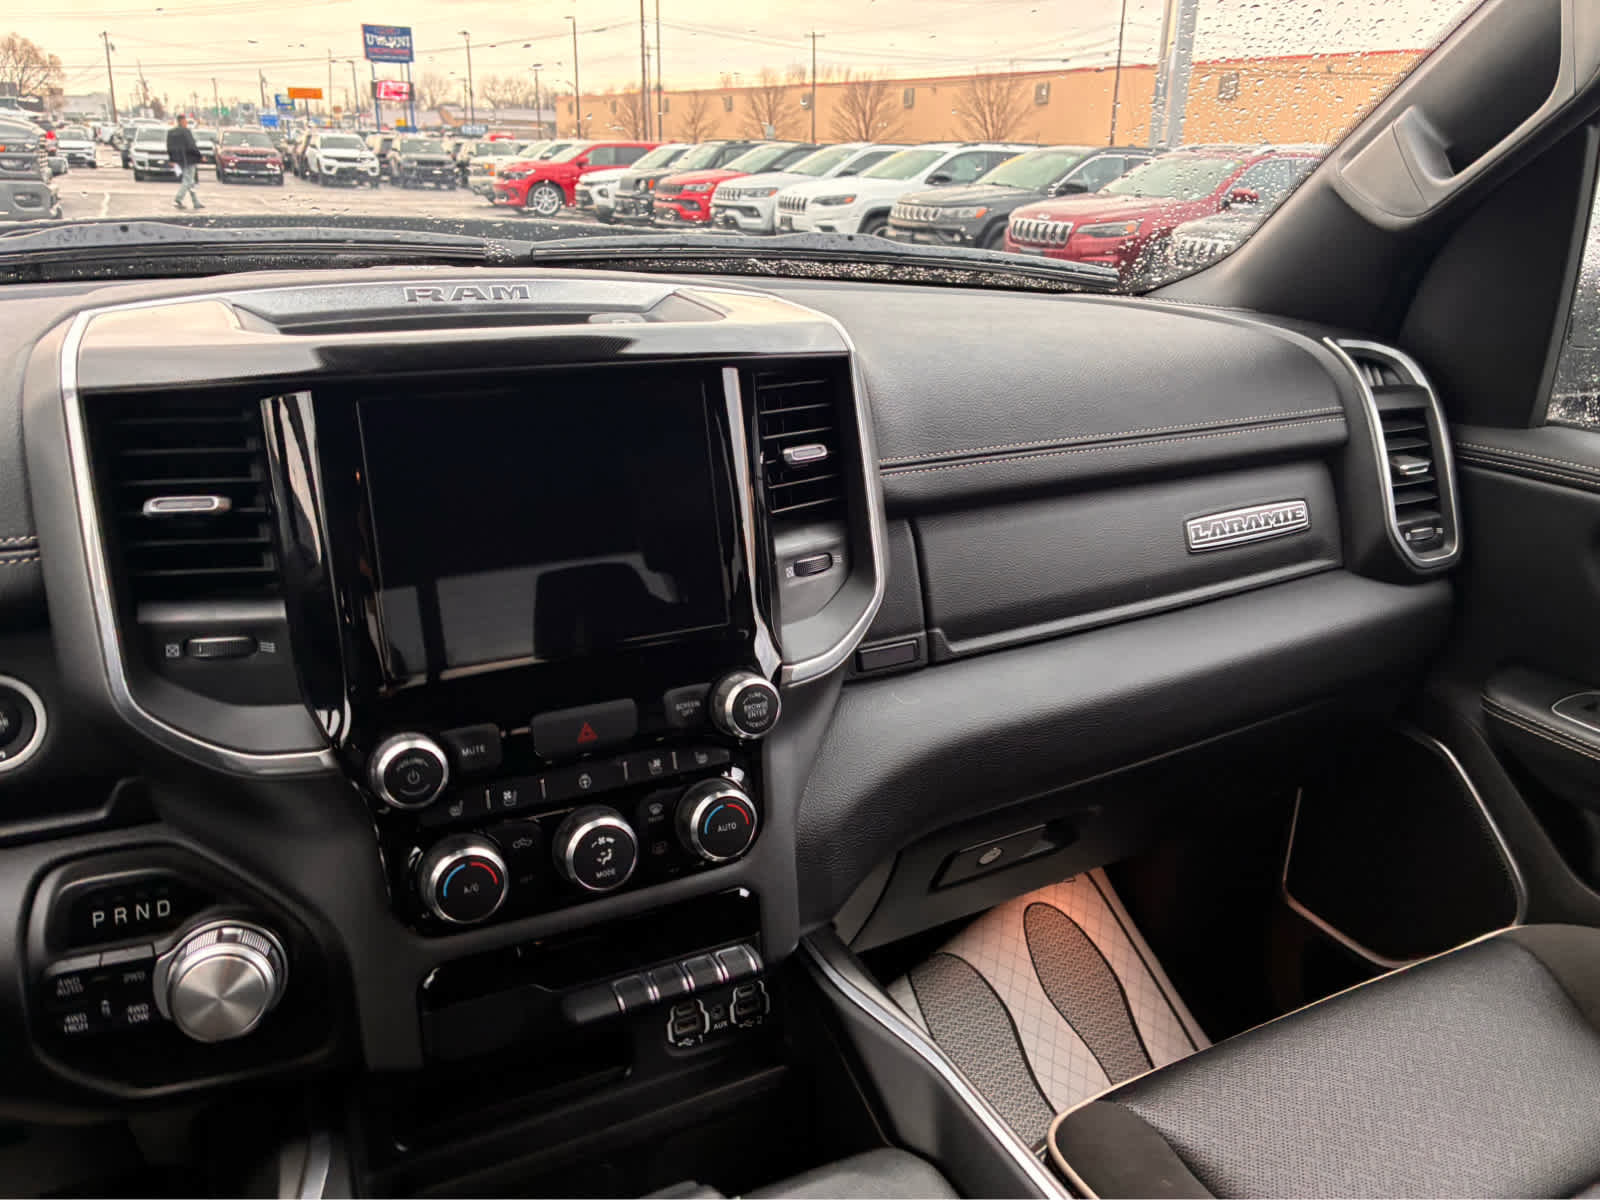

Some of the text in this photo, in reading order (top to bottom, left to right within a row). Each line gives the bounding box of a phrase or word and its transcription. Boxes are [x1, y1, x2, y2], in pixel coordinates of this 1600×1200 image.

[404, 284, 530, 303] RAM
[1190, 506, 1307, 544] LARAMIE
[675, 700, 701, 712] SCREEN
[743, 701, 769, 713] BROWSE
[747, 709, 767, 720] ENTER
[461, 744, 486, 757] MUTE
[717, 822, 737, 833] AUTO
[595, 867, 617, 879] MODE
[91, 900, 171, 928] P R N D
[127, 1003, 149, 1015] 4WD
[64, 1012, 88, 1024] 4WD
[127, 1012, 150, 1024] LOW
[713, 1021, 728, 1031] AUX
